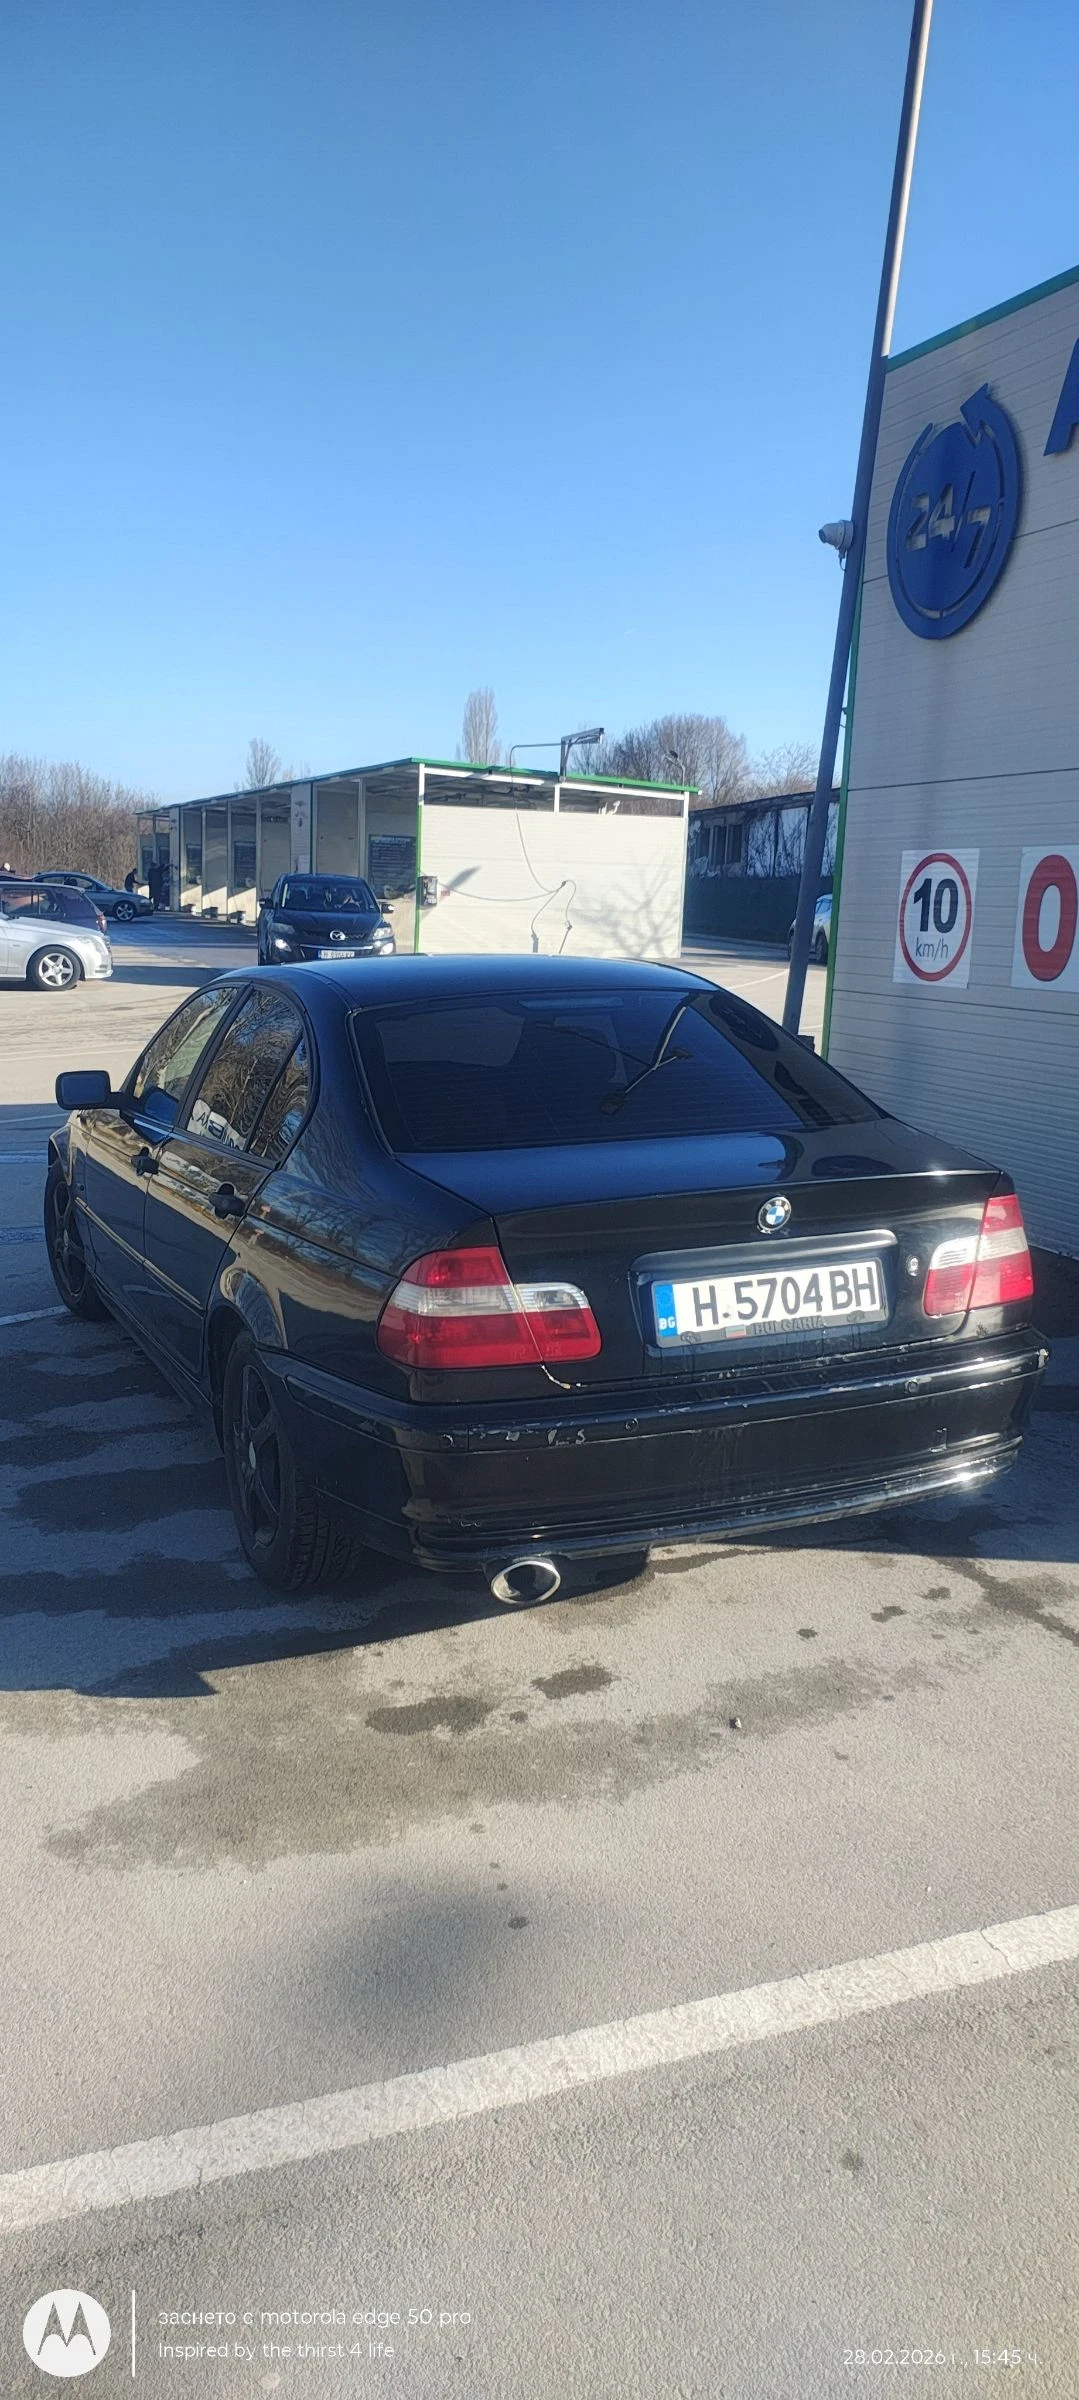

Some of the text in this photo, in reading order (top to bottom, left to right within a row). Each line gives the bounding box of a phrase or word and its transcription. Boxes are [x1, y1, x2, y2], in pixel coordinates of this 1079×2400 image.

[905, 470, 992, 569] 24/7
[913, 878, 959, 934] 10
[915, 937, 949, 961] km/h
[658, 1317, 676, 1329] BG
